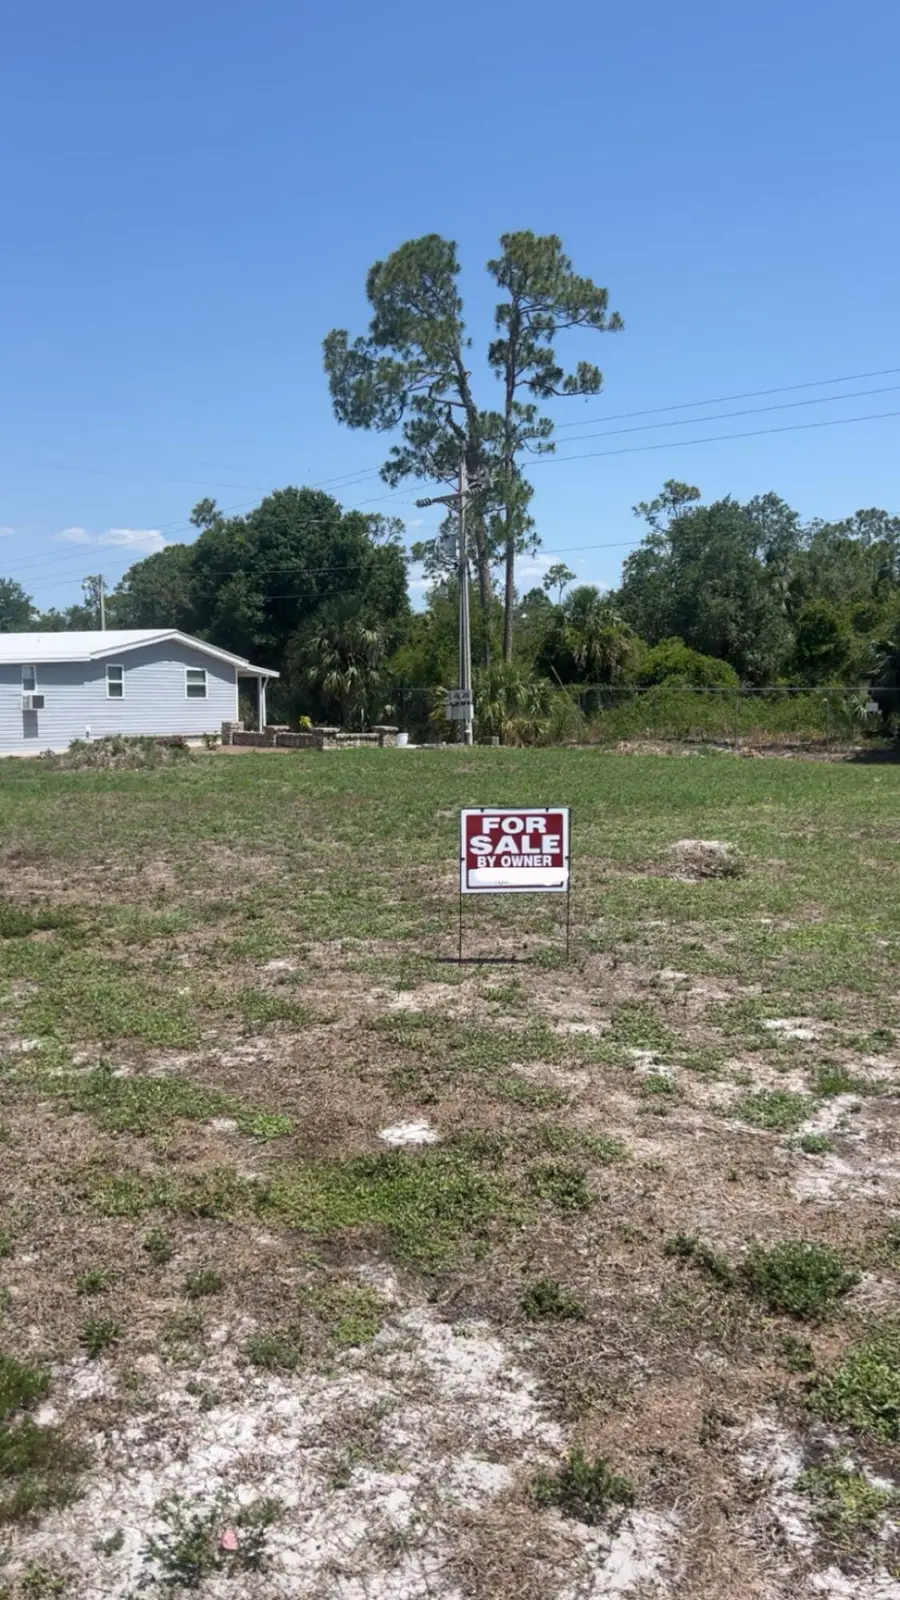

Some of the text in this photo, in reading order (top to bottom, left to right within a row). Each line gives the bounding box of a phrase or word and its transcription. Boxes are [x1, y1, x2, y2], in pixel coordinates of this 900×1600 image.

[482, 816, 547, 834] FOR
[469, 834, 561, 855] SALE
[477, 855, 552, 868] BY OWNER
